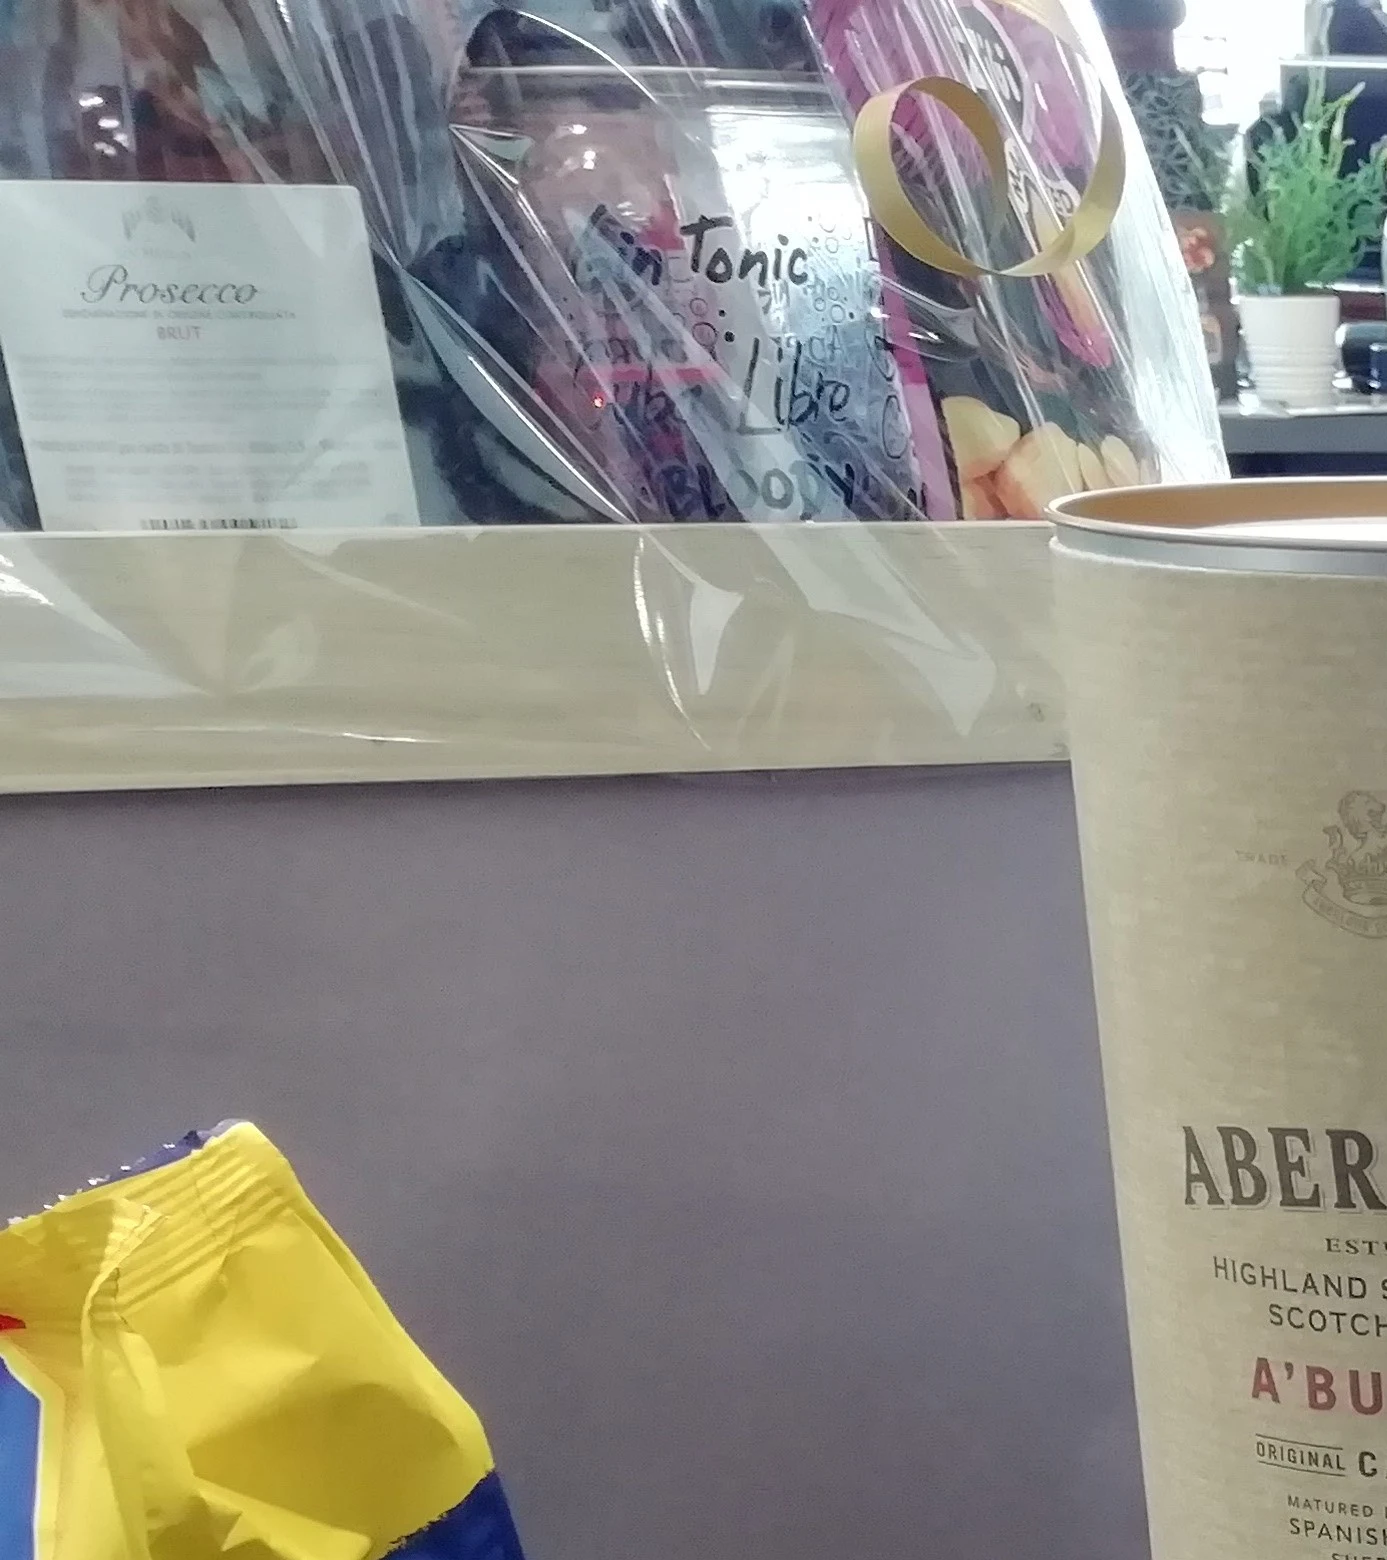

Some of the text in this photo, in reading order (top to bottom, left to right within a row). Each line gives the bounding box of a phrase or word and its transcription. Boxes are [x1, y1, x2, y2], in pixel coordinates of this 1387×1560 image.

[681, 215, 808, 284] Tonic
[80, 264, 258, 304] Prosecco
[157, 326, 200, 340] BRUT
[1213, 1256, 1367, 1300] HIGHLAND
[1255, 1440, 1346, 1471] ORIGINAL
[1287, 1494, 1374, 1518] MATURED
